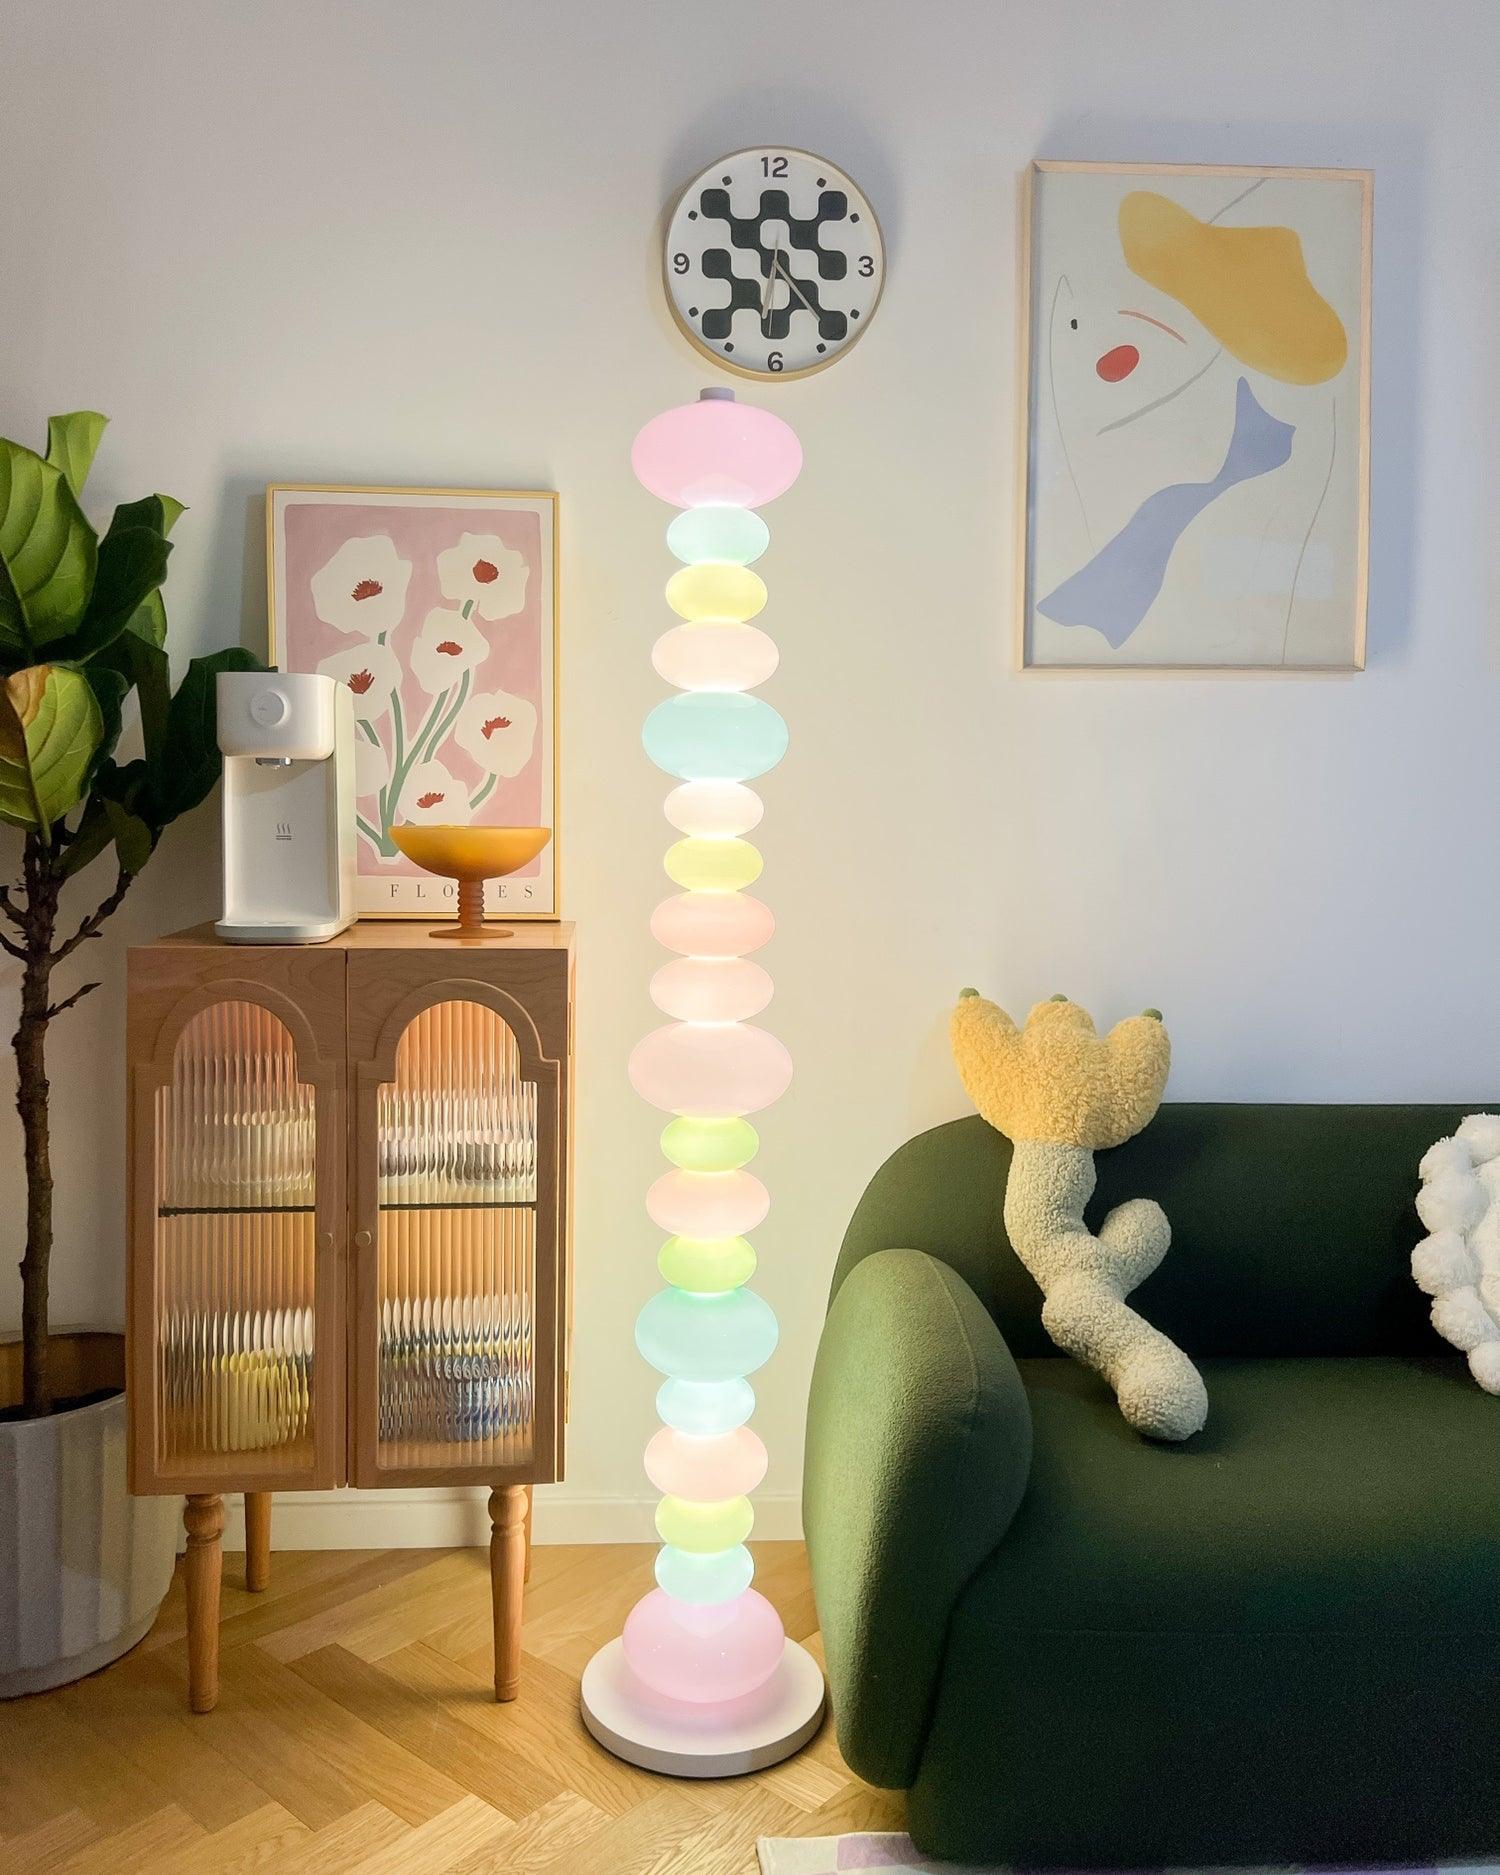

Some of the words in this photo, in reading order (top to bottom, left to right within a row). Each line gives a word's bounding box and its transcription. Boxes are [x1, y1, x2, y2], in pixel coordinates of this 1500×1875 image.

[760, 156, 789, 178] 12
[673, 252, 690, 275] 9
[857, 255, 875, 278] 3
[767, 351, 784, 373] 6
[390, 883, 533, 898] FLOES
